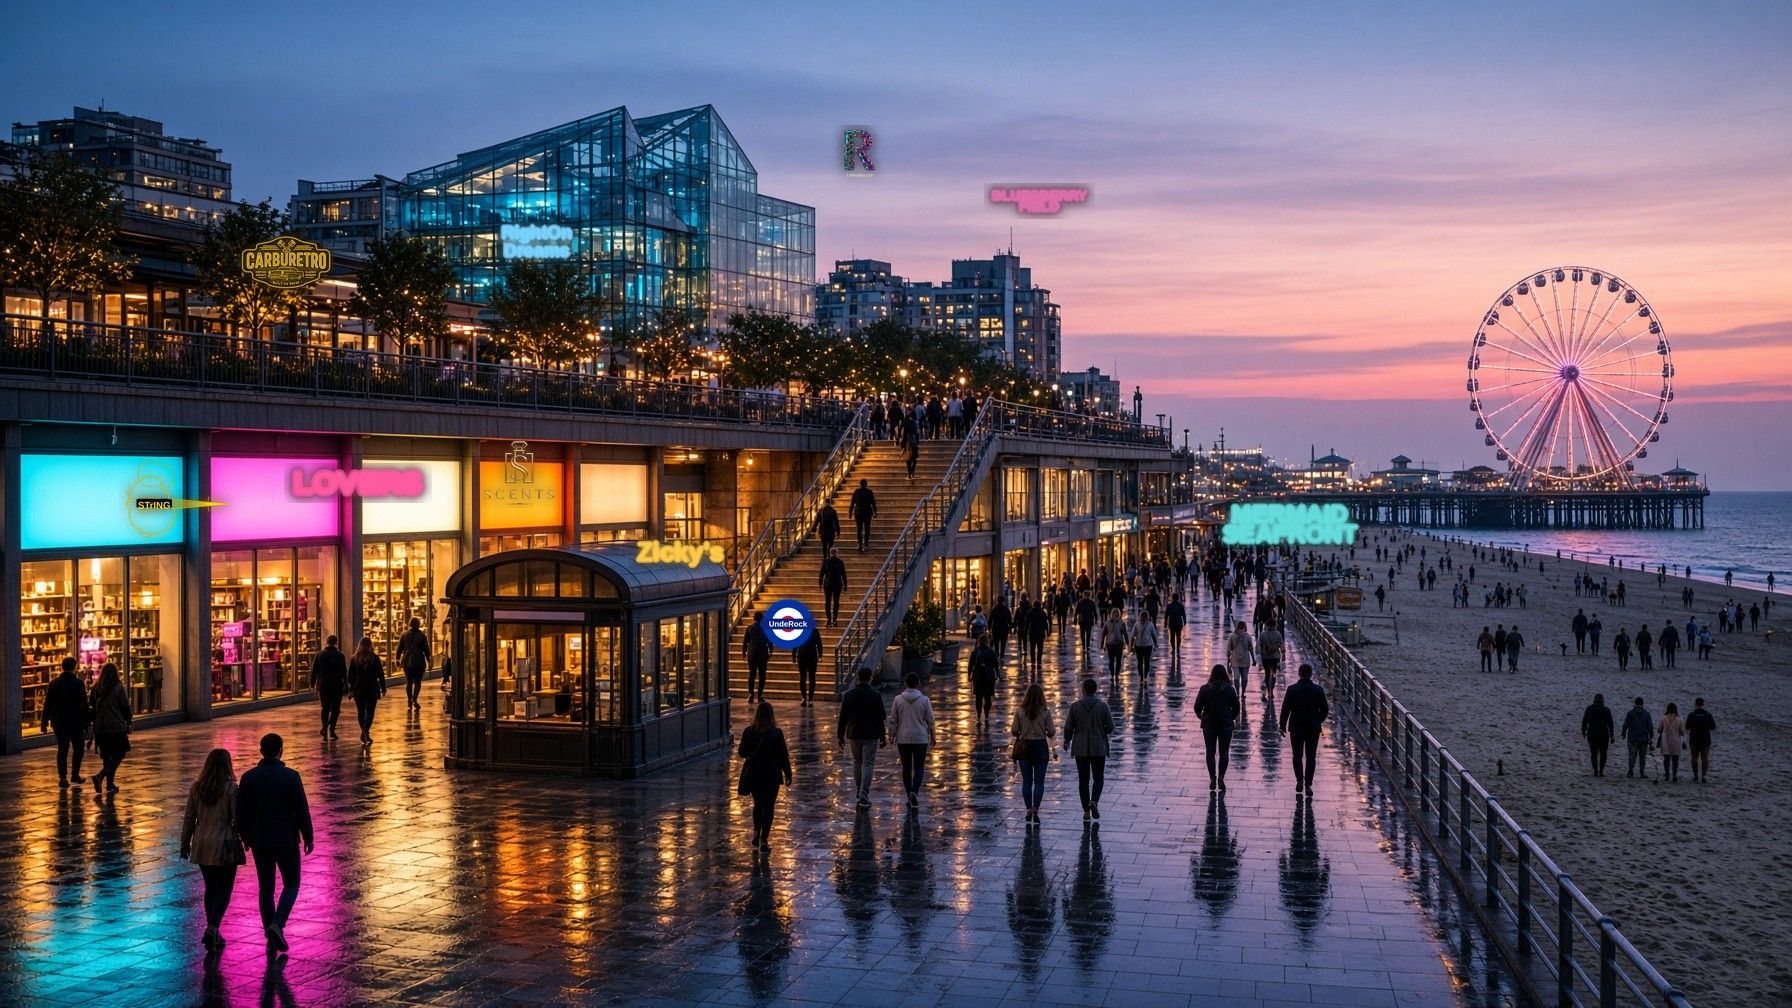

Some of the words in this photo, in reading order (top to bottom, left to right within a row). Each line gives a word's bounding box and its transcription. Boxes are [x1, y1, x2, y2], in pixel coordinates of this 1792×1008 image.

[246, 251, 327, 270] CARBURETRO
[482, 488, 556, 501] SCENTS
[1230, 503, 1349, 525] MERMAID
[1222, 523, 1360, 545] SEAFRONT
[635, 540, 726, 569] Zicky's
[768, 620, 808, 628] UndeRock
